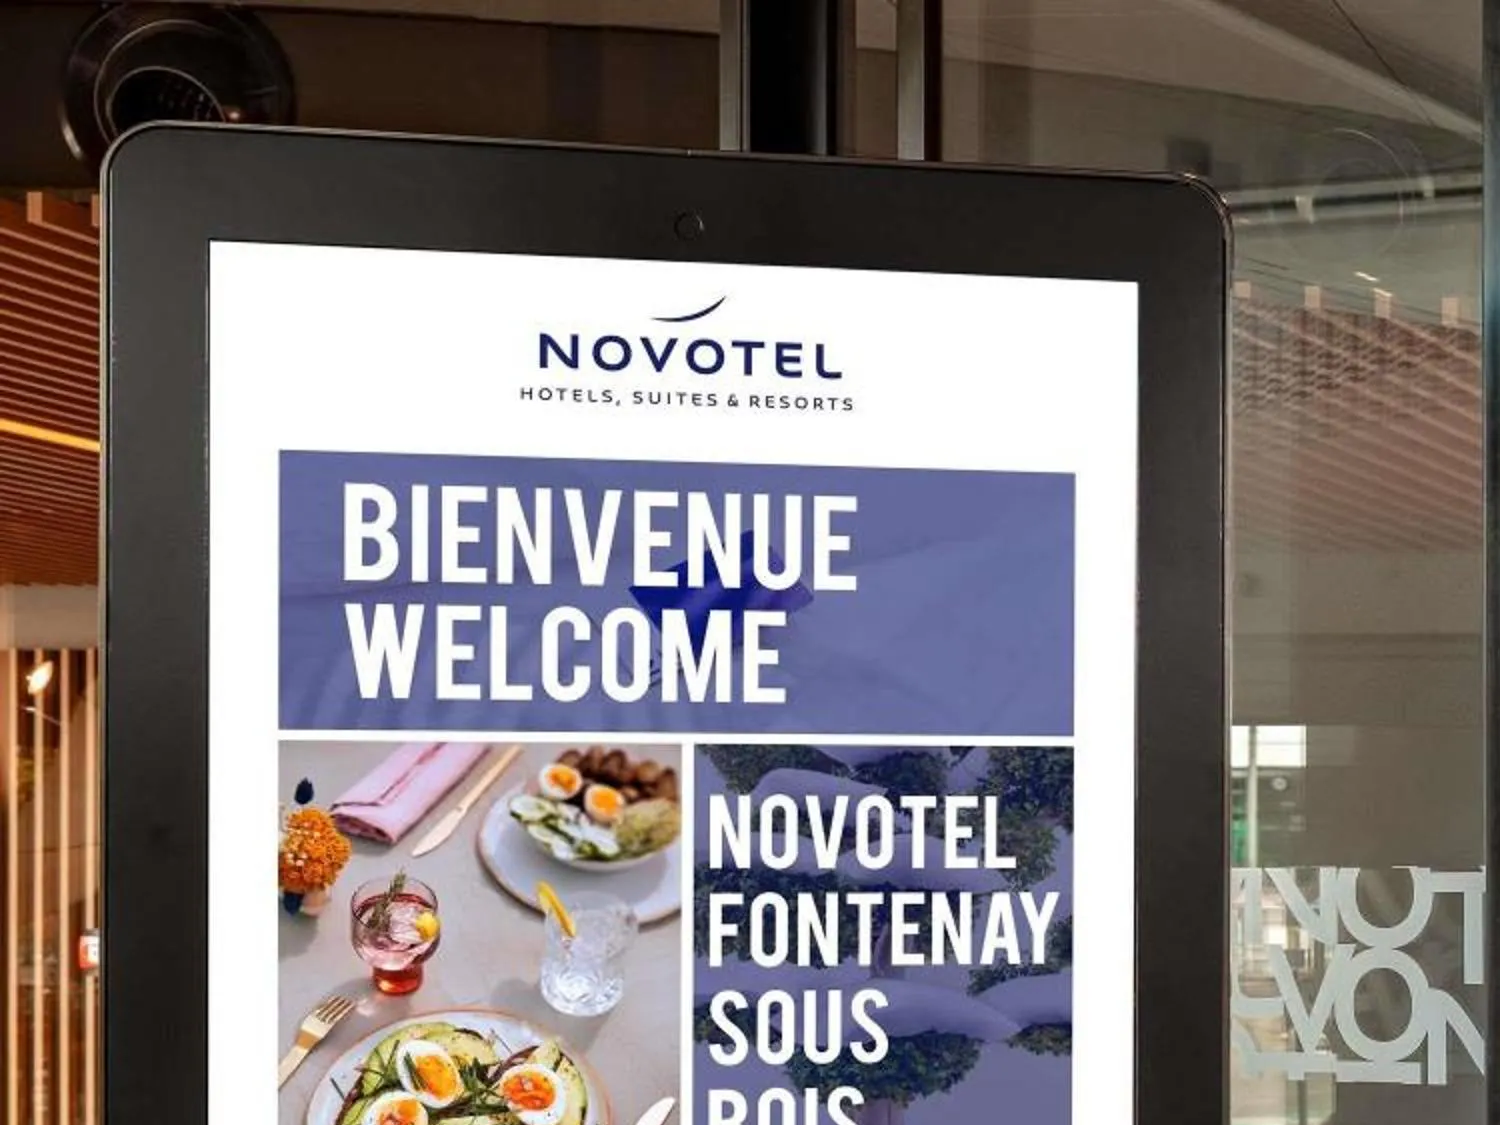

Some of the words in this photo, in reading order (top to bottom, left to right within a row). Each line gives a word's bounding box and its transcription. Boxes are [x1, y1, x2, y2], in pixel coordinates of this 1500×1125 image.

[538, 331, 844, 380] NOVOTEL
[519, 386, 622, 408] HOTELS,
[632, 389, 719, 408] SUITES
[726, 392, 740, 409] &
[748, 393, 854, 412] RESORTS
[342, 481, 859, 593] BIENVENUE
[344, 602, 788, 705] WELCOME
[708, 793, 1018, 870] NOVOTEL
[708, 890, 1060, 968] FONTENAY
[708, 988, 890, 1067] SOUS
